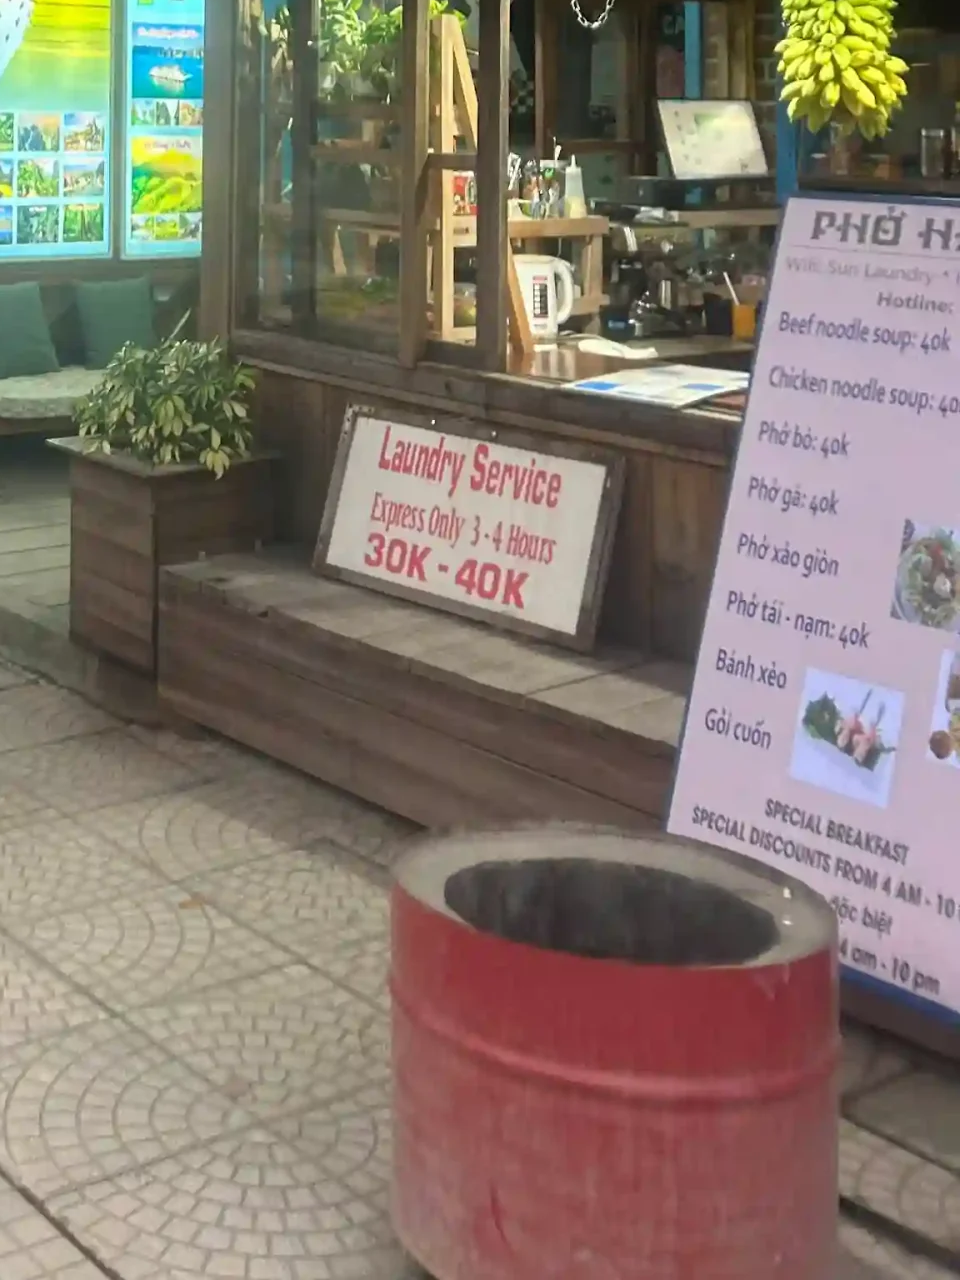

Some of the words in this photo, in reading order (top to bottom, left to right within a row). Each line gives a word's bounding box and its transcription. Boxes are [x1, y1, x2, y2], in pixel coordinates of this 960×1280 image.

[810, 206, 908, 246] PHỞ
[864, 263, 933, 288] Laundry
[876, 291, 954, 314] Hotline:
[778, 310, 816, 336] Beef
[815, 317, 870, 344] noodle
[872, 326, 918, 356] soup:
[920, 326, 952, 355] 40k
[768, 365, 828, 395] Chicken
[830, 377, 887, 404] noodle
[889, 387, 935, 416] soup:
[938, 394, 960, 418] 40
[758, 419, 791, 448] Phở
[820, 431, 851, 459] 40k
[378, 426, 466, 498] Laundry
[470, 443, 562, 509] Service
[747, 475, 780, 504] Phở
[809, 489, 840, 517] 40k
[370, 492, 426, 534] Express
[428, 506, 466, 548] Only
[506, 524, 558, 565] Hours
[737, 532, 770, 561] Phở
[364, 533, 432, 583] 30K
[454, 559, 530, 610] 40K
[726, 589, 759, 619] Phở
[838, 621, 872, 650] 40k
[715, 648, 755, 682] Bánh
[705, 706, 732, 737] Gỏi
[733, 718, 772, 750] cuốn
[764, 798, 824, 836] SPECIAL
[826, 820, 910, 866] BREAKFAST
[691, 805, 746, 841] SPECIAL
[749, 826, 832, 873] DISCOUNTS
[834, 858, 878, 891] FROM
[881, 876, 892, 897] 4
[895, 881, 922, 907] AM
[937, 893, 956, 918] 10
[851, 946, 877, 970] am
[892, 957, 911, 983] 10
[913, 970, 941, 996] pm
